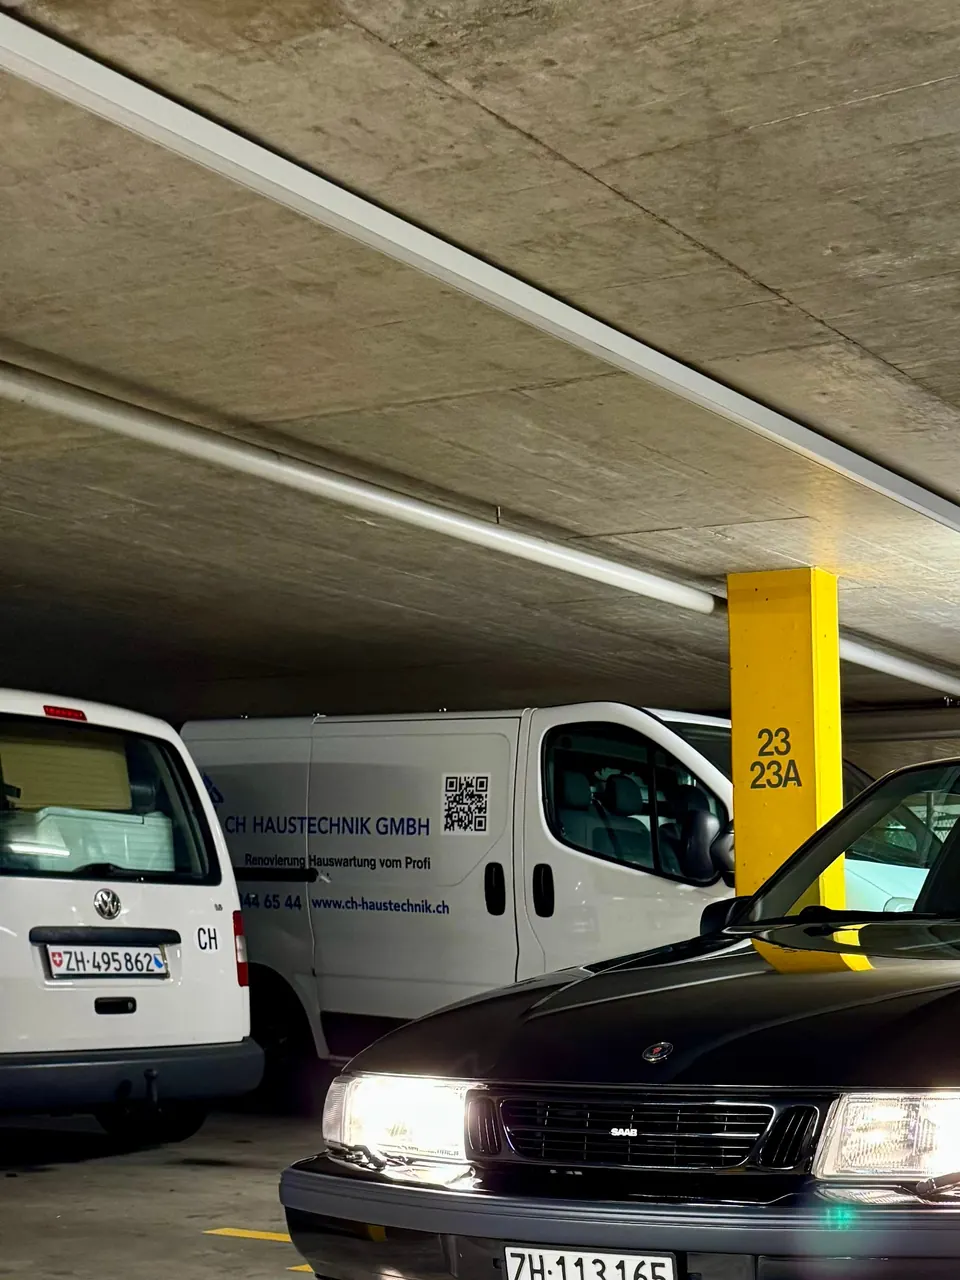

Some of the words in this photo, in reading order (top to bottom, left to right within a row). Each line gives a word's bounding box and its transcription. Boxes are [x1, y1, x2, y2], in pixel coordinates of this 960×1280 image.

[757, 727, 791, 756] 23
[749, 759, 802, 789] 23A
[224, 815, 246, 834] CH
[253, 815, 371, 835] HAUSTECHNIK
[375, 816, 430, 836] GMBH
[244, 853, 306, 869] Renovierung
[309, 854, 377, 871] Hauswartung
[379, 857, 402, 869] vom
[405, 856, 431, 870] Profi
[263, 893, 281, 910] 65
[284, 894, 302, 911] 44
[311, 896, 450, 915] www.ch-haustechnik.ch
[197, 927, 218, 951] CH
[610, 1127, 638, 1137] SAAB
